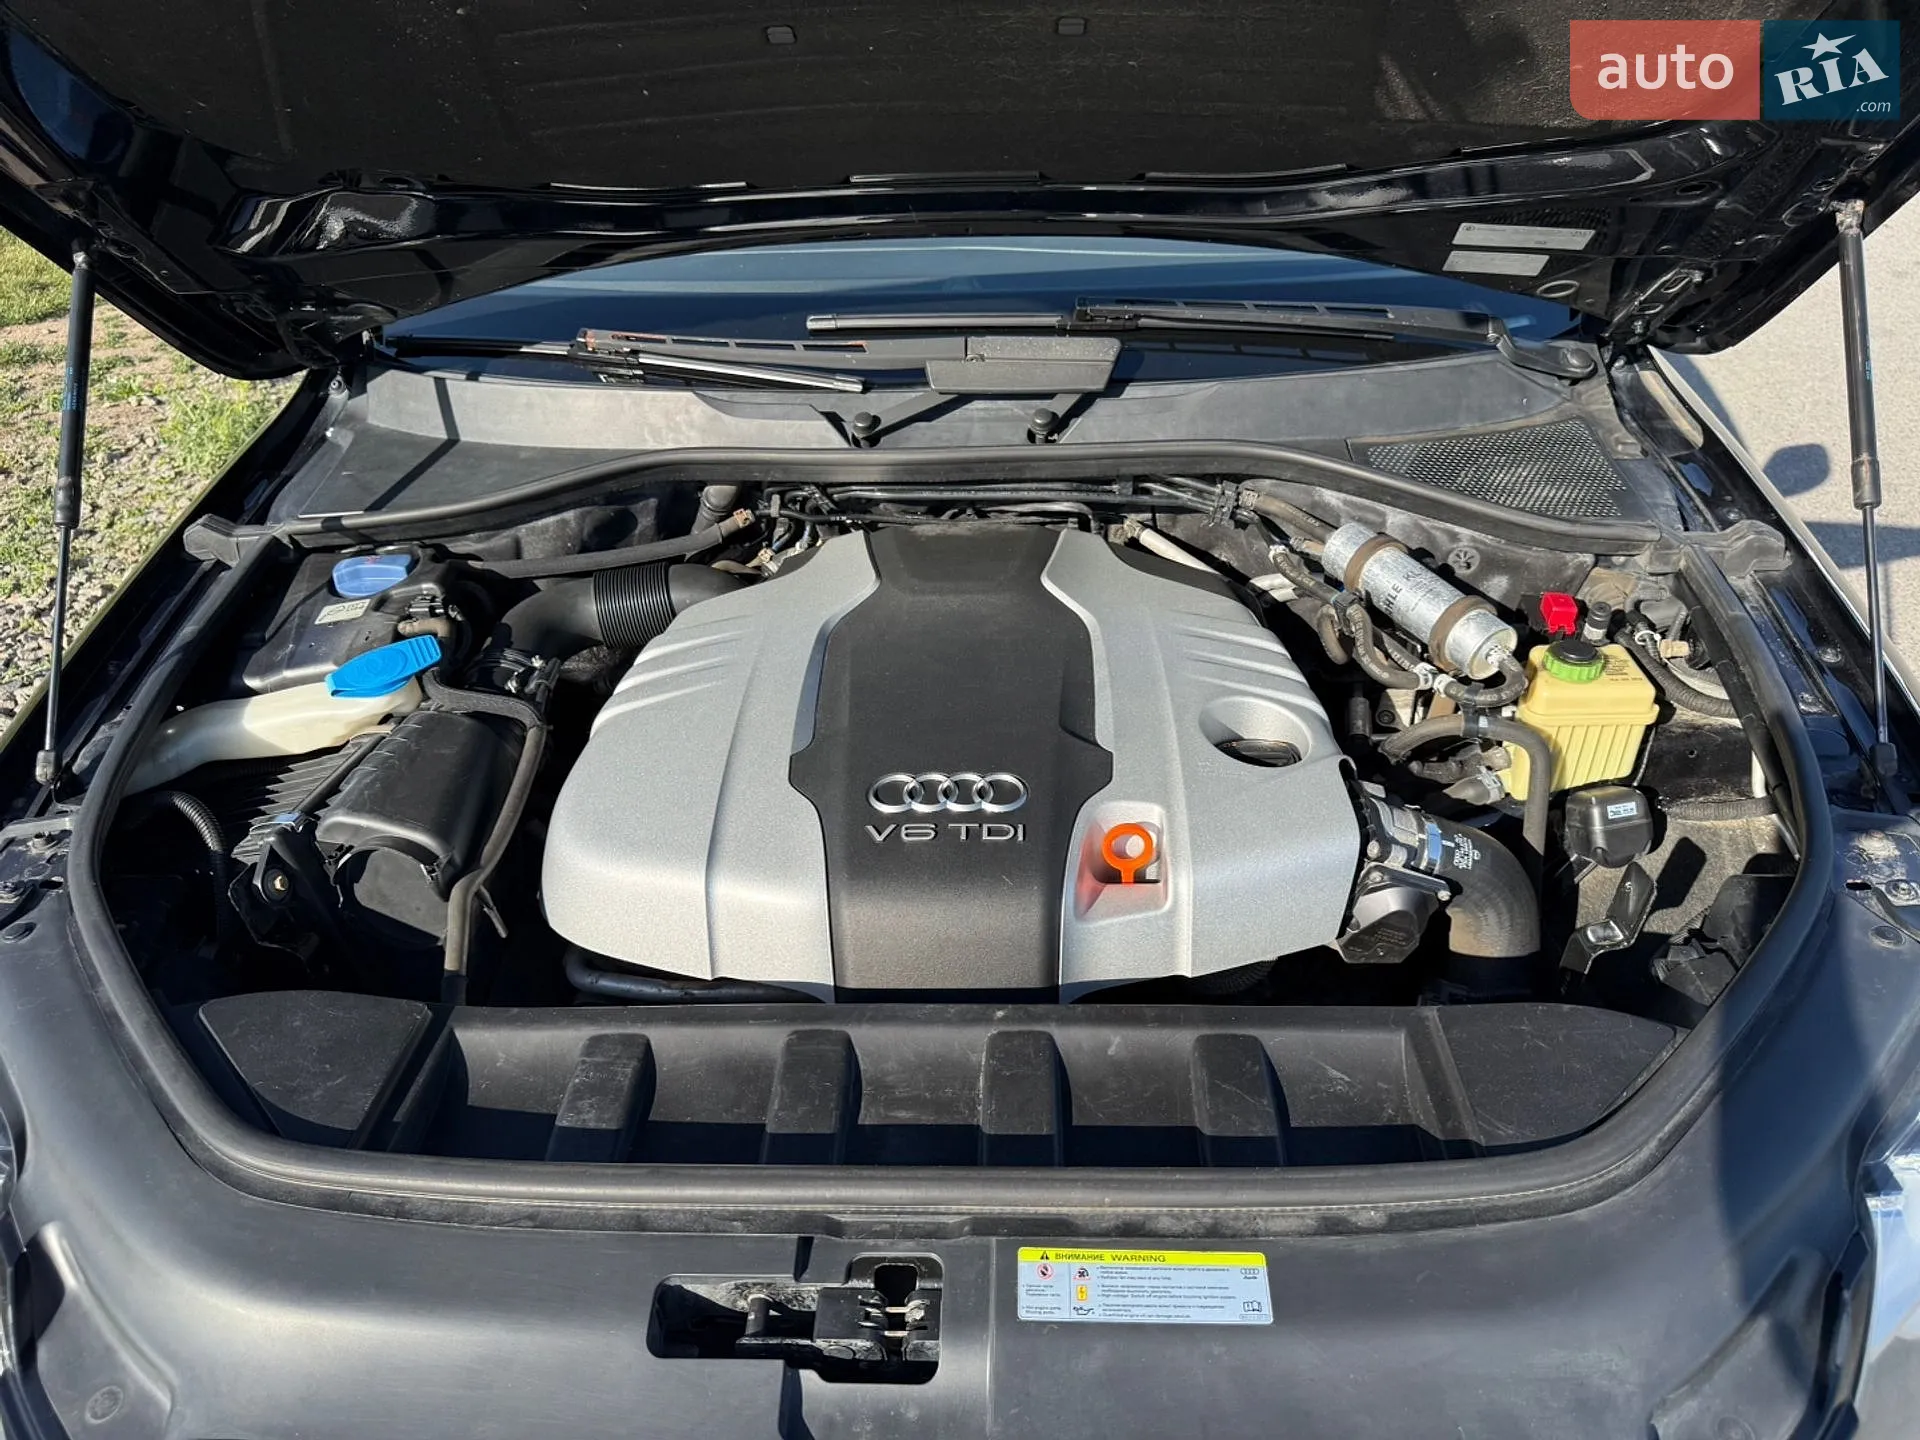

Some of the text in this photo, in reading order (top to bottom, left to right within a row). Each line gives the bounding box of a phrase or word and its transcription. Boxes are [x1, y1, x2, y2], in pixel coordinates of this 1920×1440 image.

[865, 823, 1026, 842] V6 TDI
[1054, 1252, 1167, 1263] ВНИМАНИЕ WARNING
